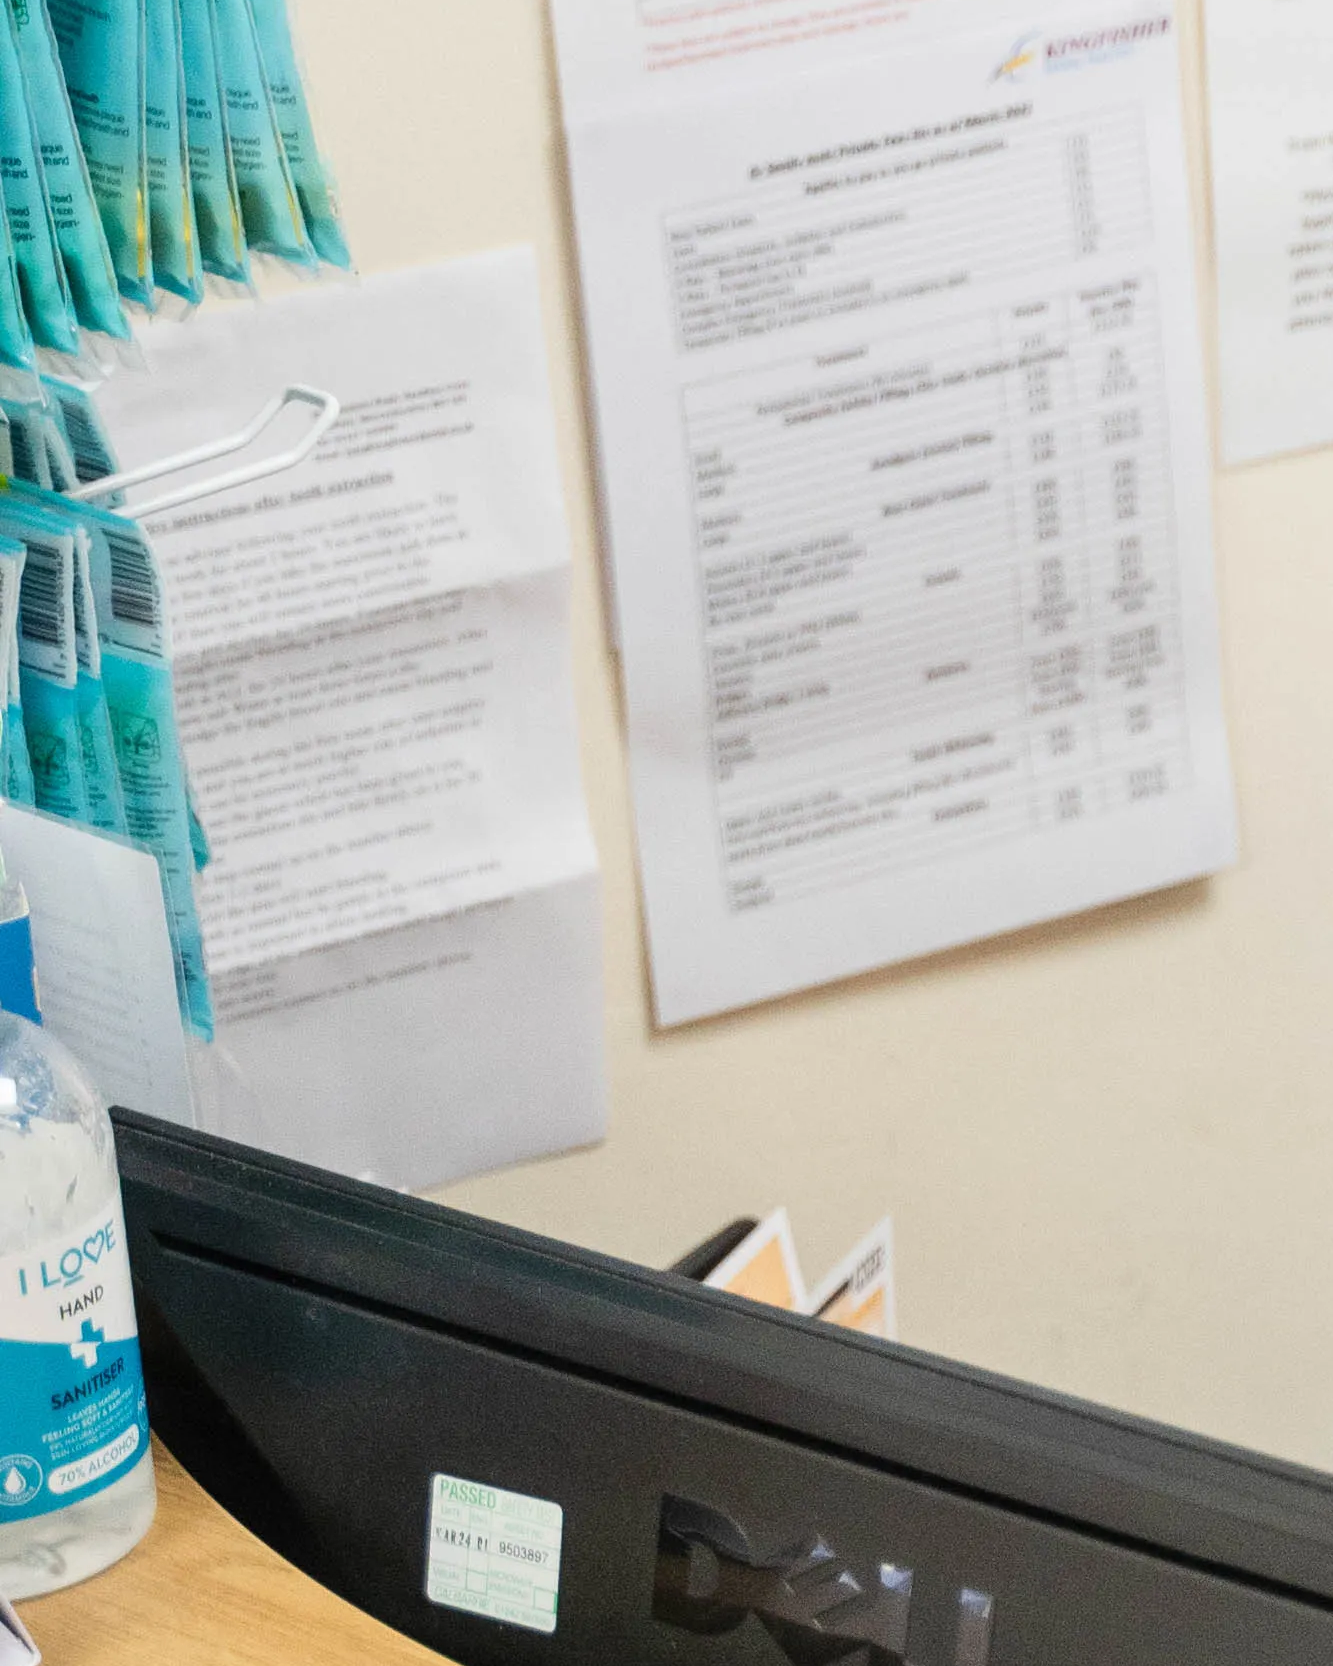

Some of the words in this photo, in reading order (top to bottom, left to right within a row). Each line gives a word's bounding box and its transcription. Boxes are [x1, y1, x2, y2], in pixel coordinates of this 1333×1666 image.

[19, 1268, 28, 1297] I
[59, 1285, 104, 1321] HAND
[51, 1356, 125, 1411] SANITISER
[59, 1467, 87, 1486] 70%
[89, 1431, 137, 1474] ALCOHOL
[440, 1479, 496, 1510] PASSED
[499, 1541, 549, 1564] 9503897
